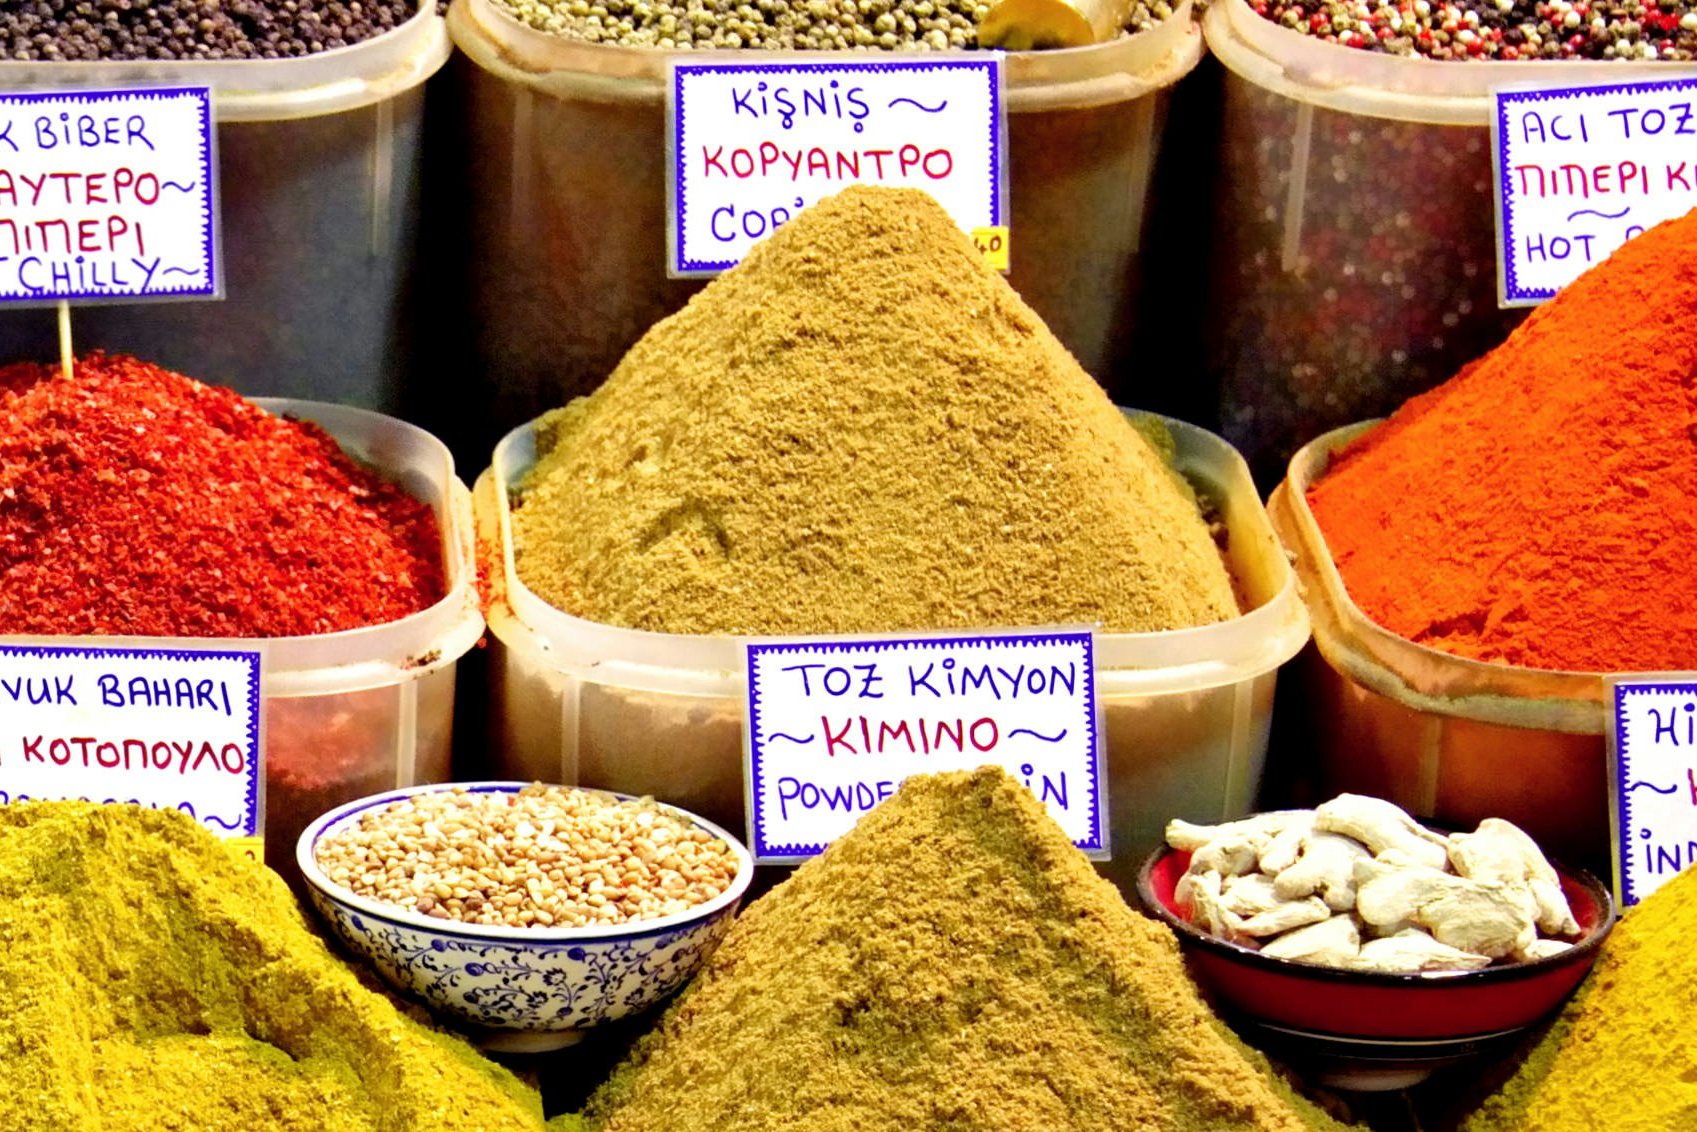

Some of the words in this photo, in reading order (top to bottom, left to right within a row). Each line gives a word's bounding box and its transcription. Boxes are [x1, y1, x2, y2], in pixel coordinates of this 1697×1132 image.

[1522, 111, 1588, 144] ACI
[1607, 102, 1696, 139] TOZ
[702, 141, 954, 182] ΚΟΡΥΑΝΤΡΟ
[1514, 160, 1649, 199] ΠΙΠΕΡΙ
[1526, 232, 1596, 263] HOT
[97, 672, 232, 717] BAHARI
[781, 662, 884, 699] TOZ
[22, 734, 245, 775] ΚΟΤΟΠΟΥΛΟ
